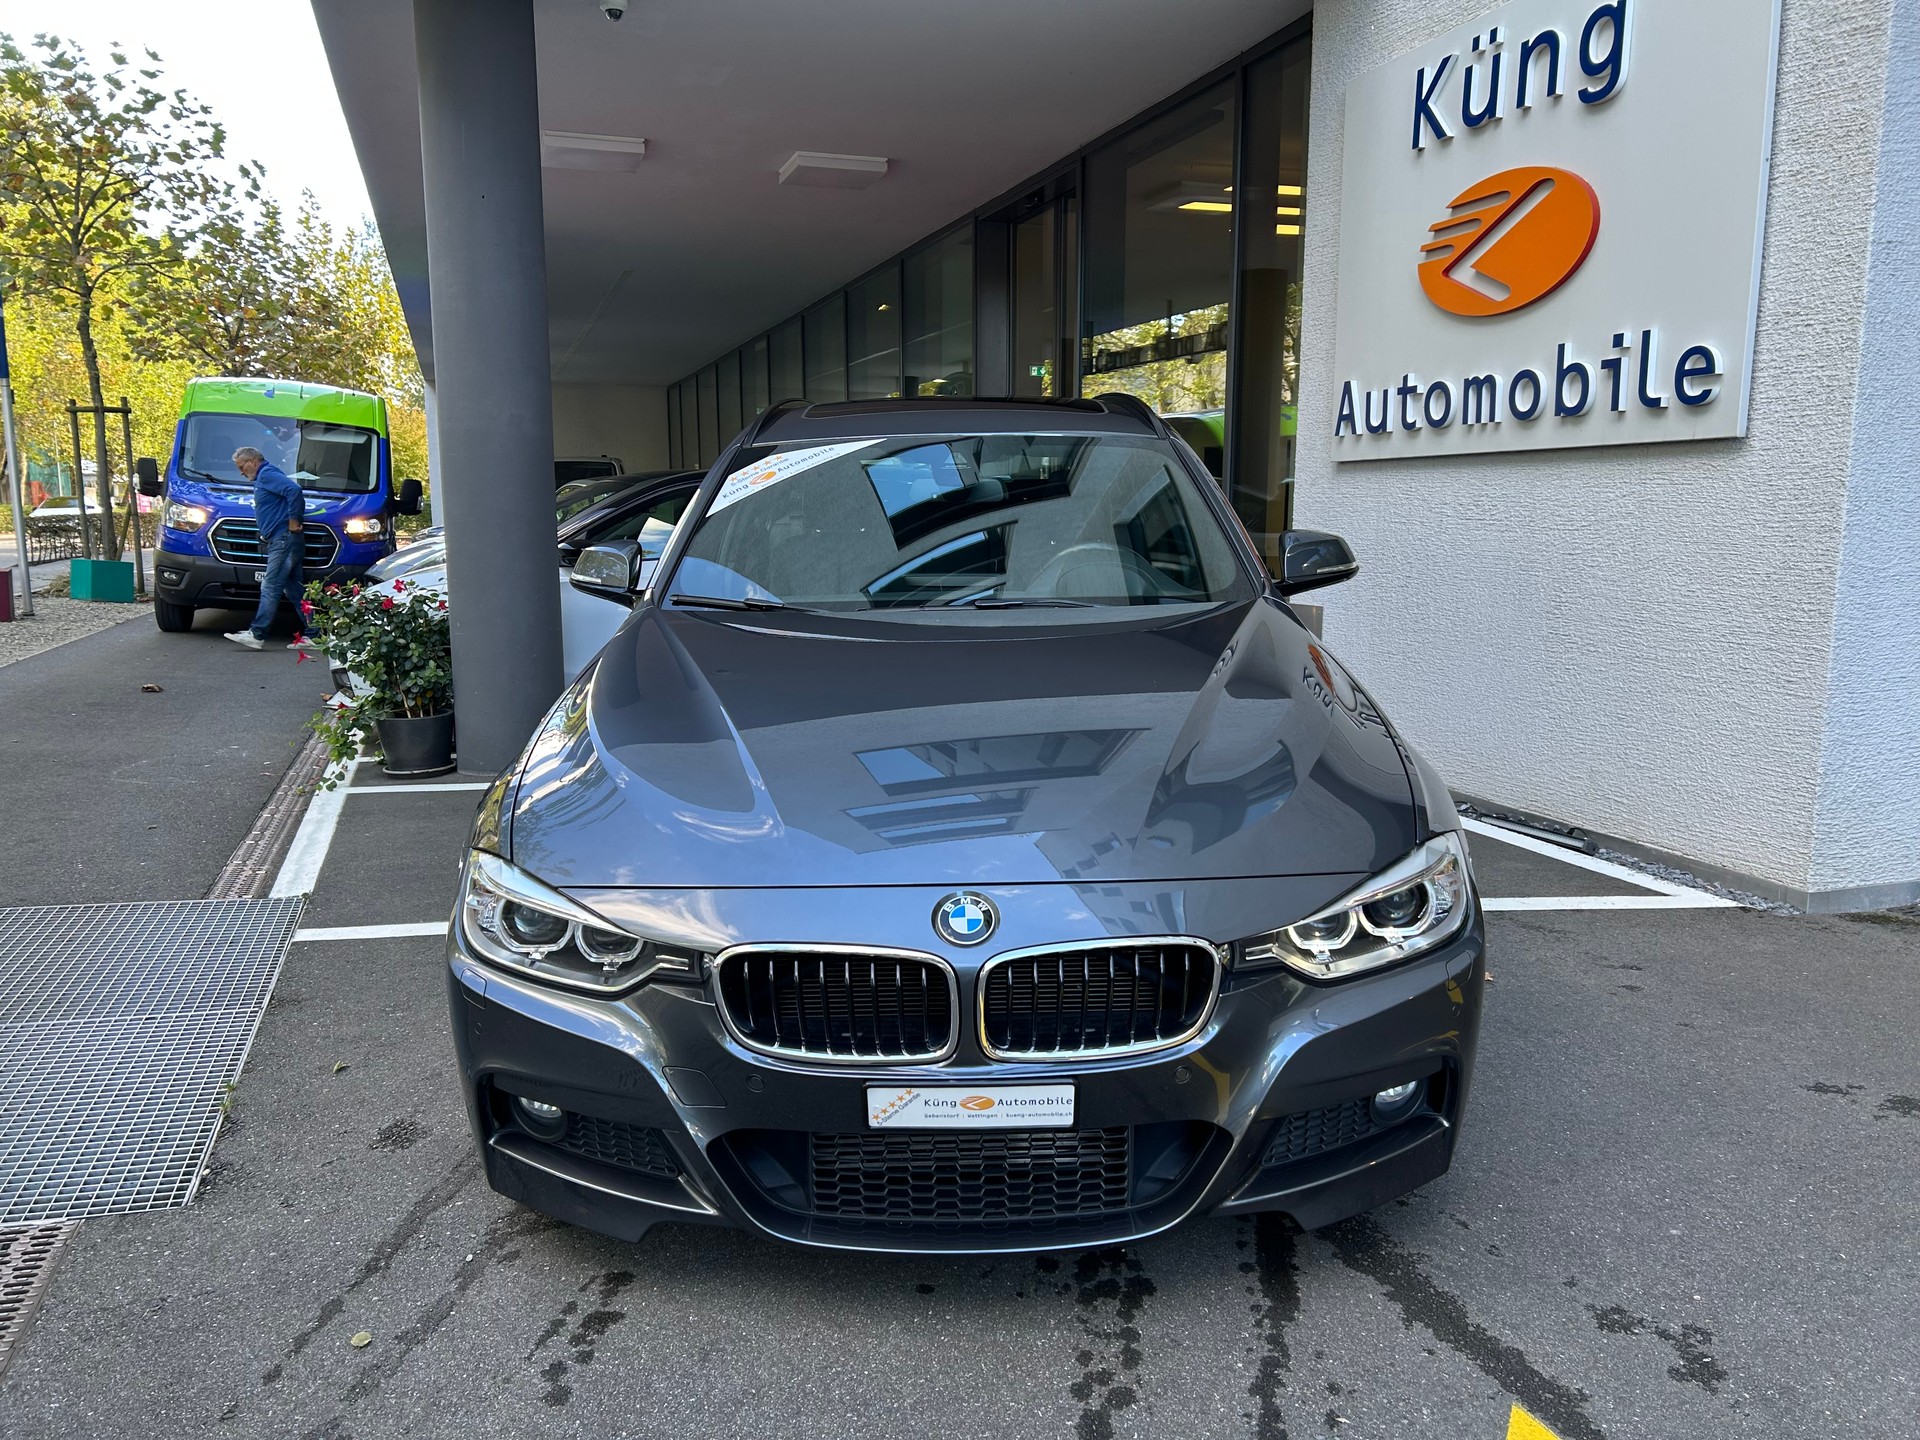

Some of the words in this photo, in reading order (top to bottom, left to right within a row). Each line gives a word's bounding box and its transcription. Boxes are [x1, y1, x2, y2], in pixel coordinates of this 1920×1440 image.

[1412, 0, 1632, 151] Küng
[1335, 329, 1724, 437] Automobile
[722, 483, 749, 499] Küng
[777, 446, 835, 473] Automobile
[943, 897, 989, 912] BMW
[924, 1098, 957, 1108] Küng
[997, 1097, 1073, 1107] Automobile
